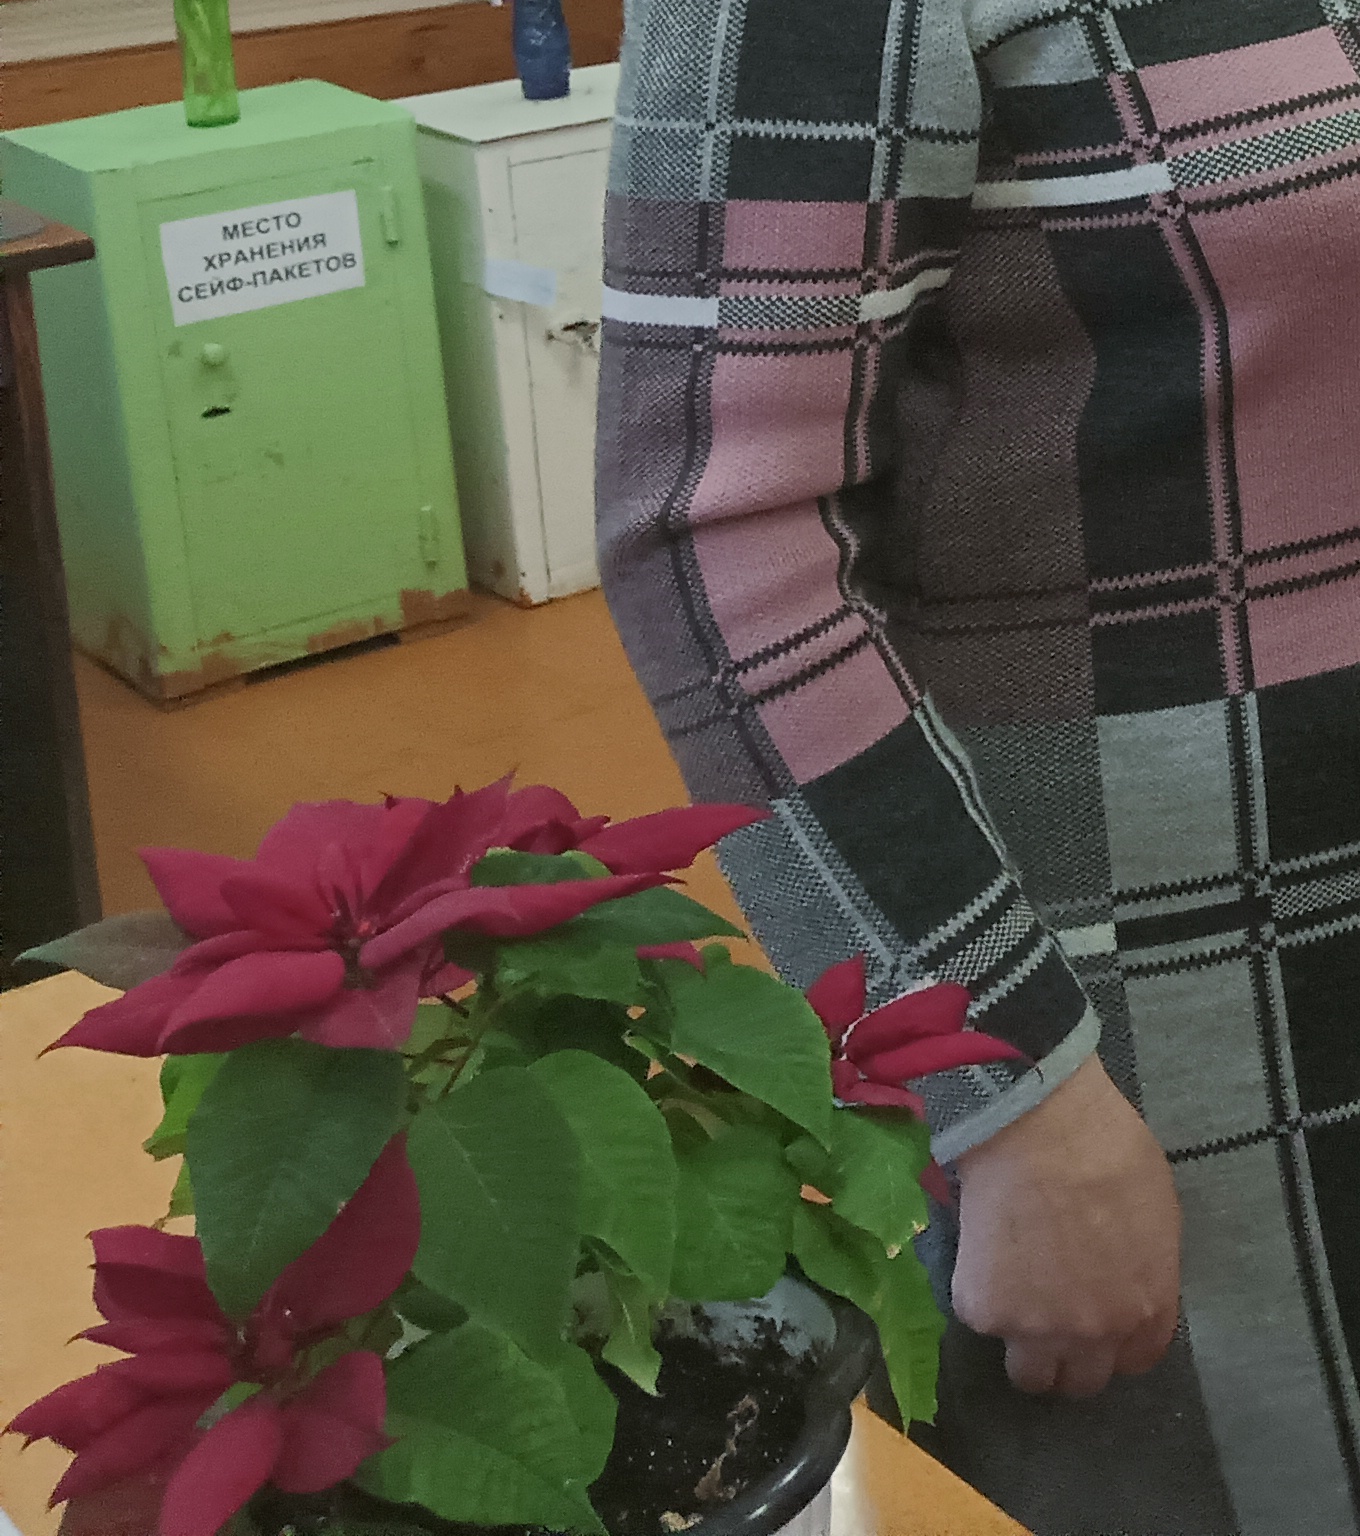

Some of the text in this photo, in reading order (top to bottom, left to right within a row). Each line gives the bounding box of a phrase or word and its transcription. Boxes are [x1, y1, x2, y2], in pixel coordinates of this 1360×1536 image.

[222, 212, 303, 242] МЕСТО
[203, 232, 328, 273] ХРАНЕНИЯ
[177, 252, 358, 304] СЕЙФ-ПАКЕТОВ
